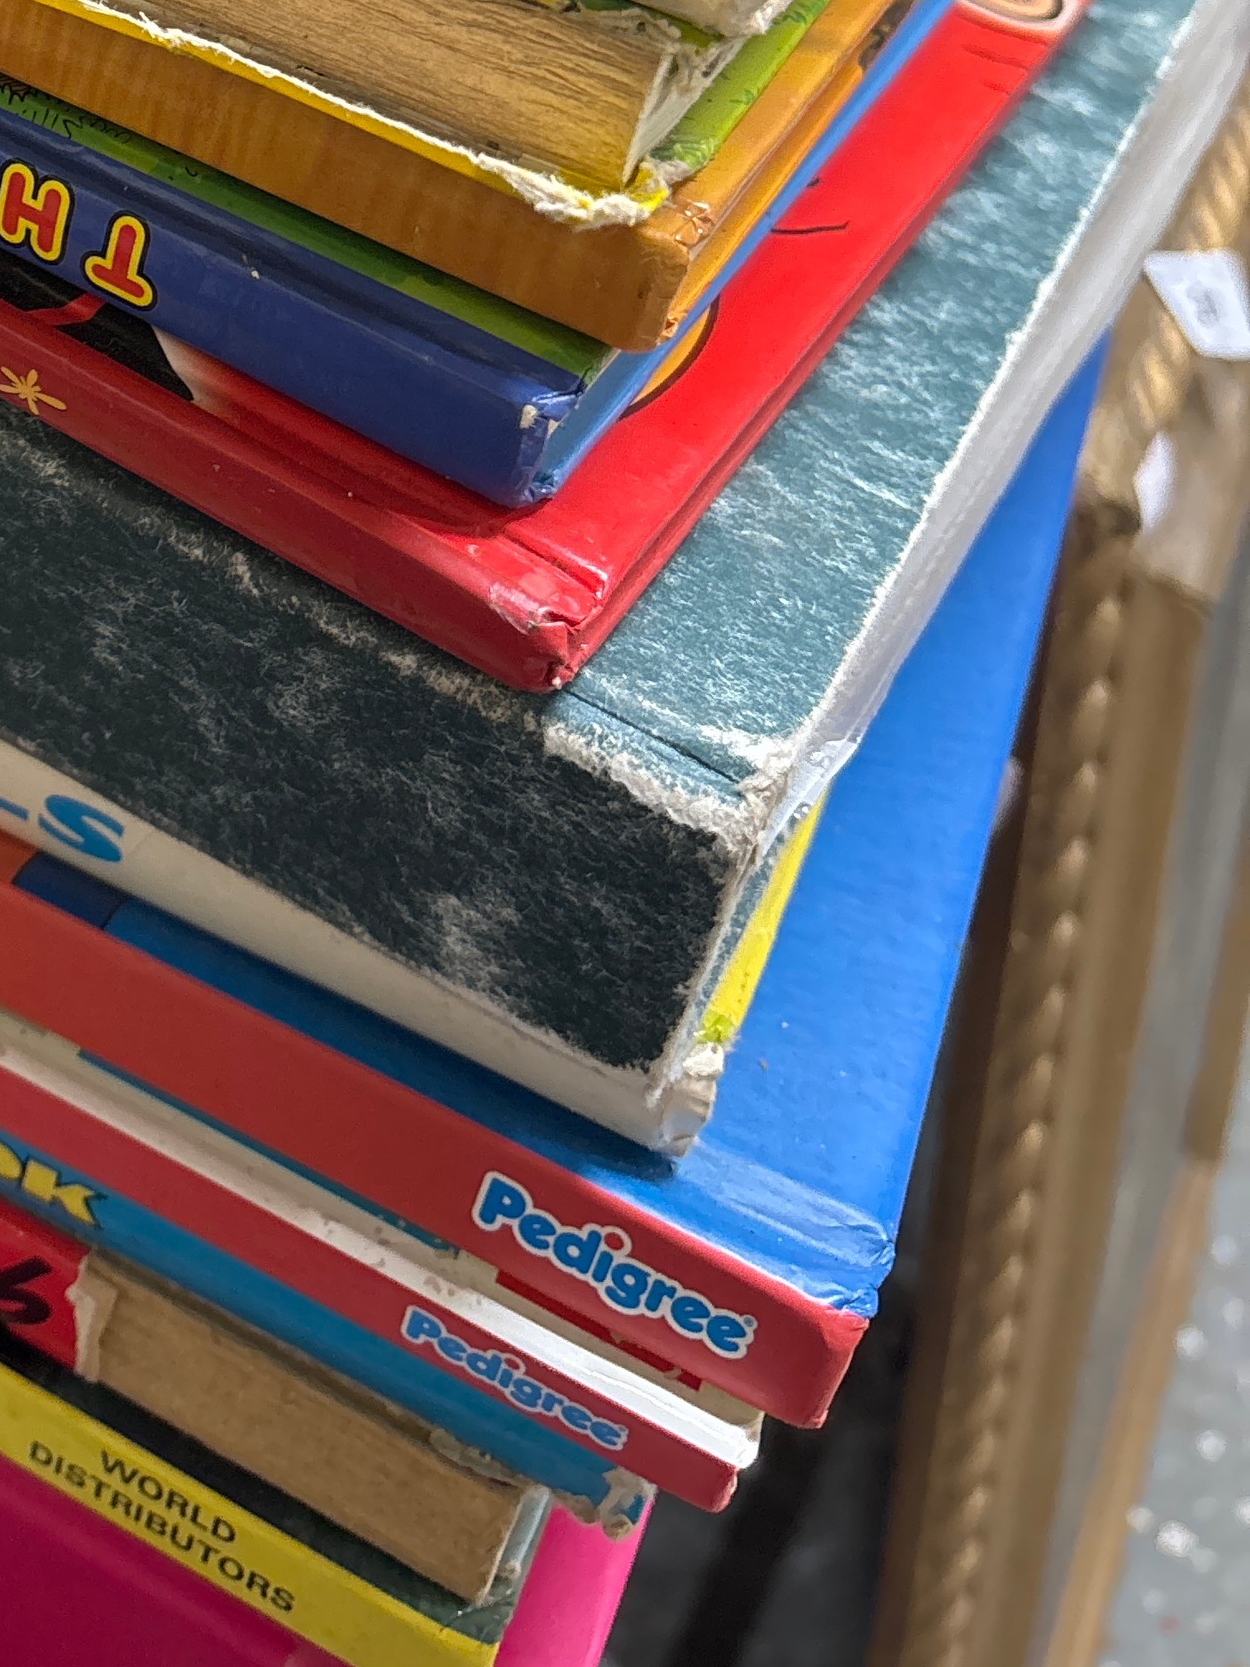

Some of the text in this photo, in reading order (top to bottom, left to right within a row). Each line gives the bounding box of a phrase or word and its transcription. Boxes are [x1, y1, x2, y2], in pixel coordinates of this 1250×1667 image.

[475, 1174, 753, 1356] Pedigree
[403, 1307, 627, 1450] Pedigree
[29, 1441, 296, 1613] DISTRIBUTORS
[100, 1449, 238, 1544] WORLD
